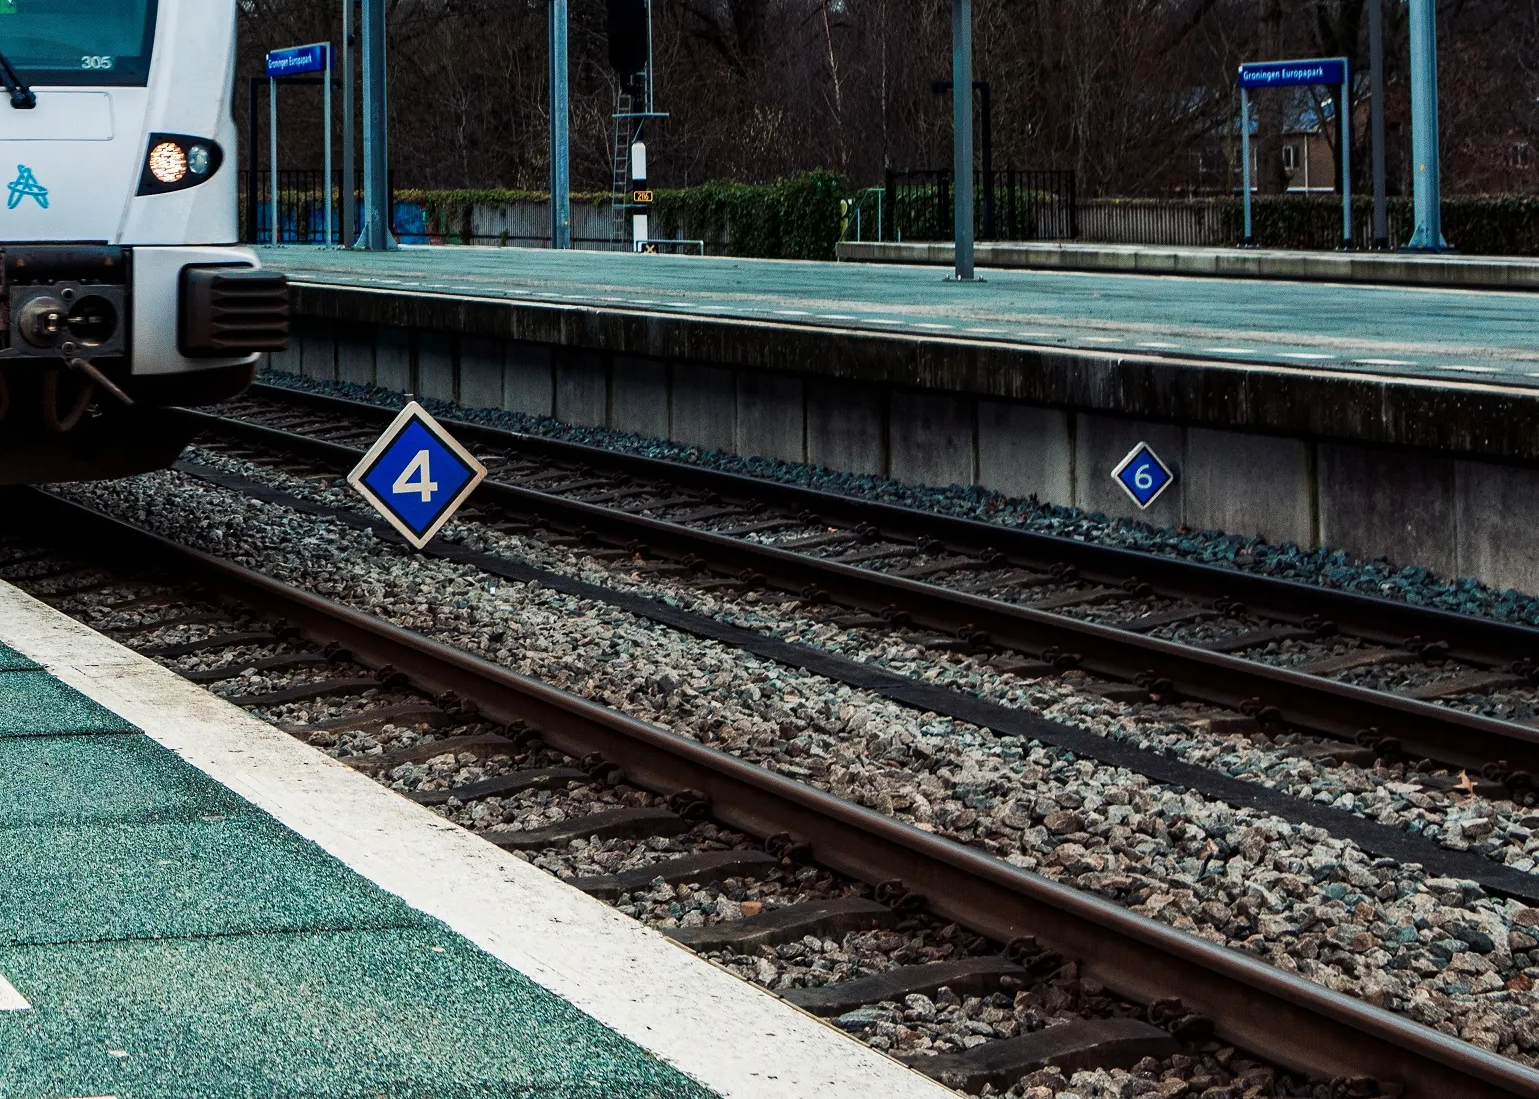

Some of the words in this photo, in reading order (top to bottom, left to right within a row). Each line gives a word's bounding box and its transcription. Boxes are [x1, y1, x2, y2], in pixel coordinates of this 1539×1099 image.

[81, 55, 113, 69] 305
[1243, 69, 1280, 82] Groningen
[1281, 66, 1323, 80] Europapark
[392, 449, 438, 503] 4
[1134, 463, 1153, 489] 6
